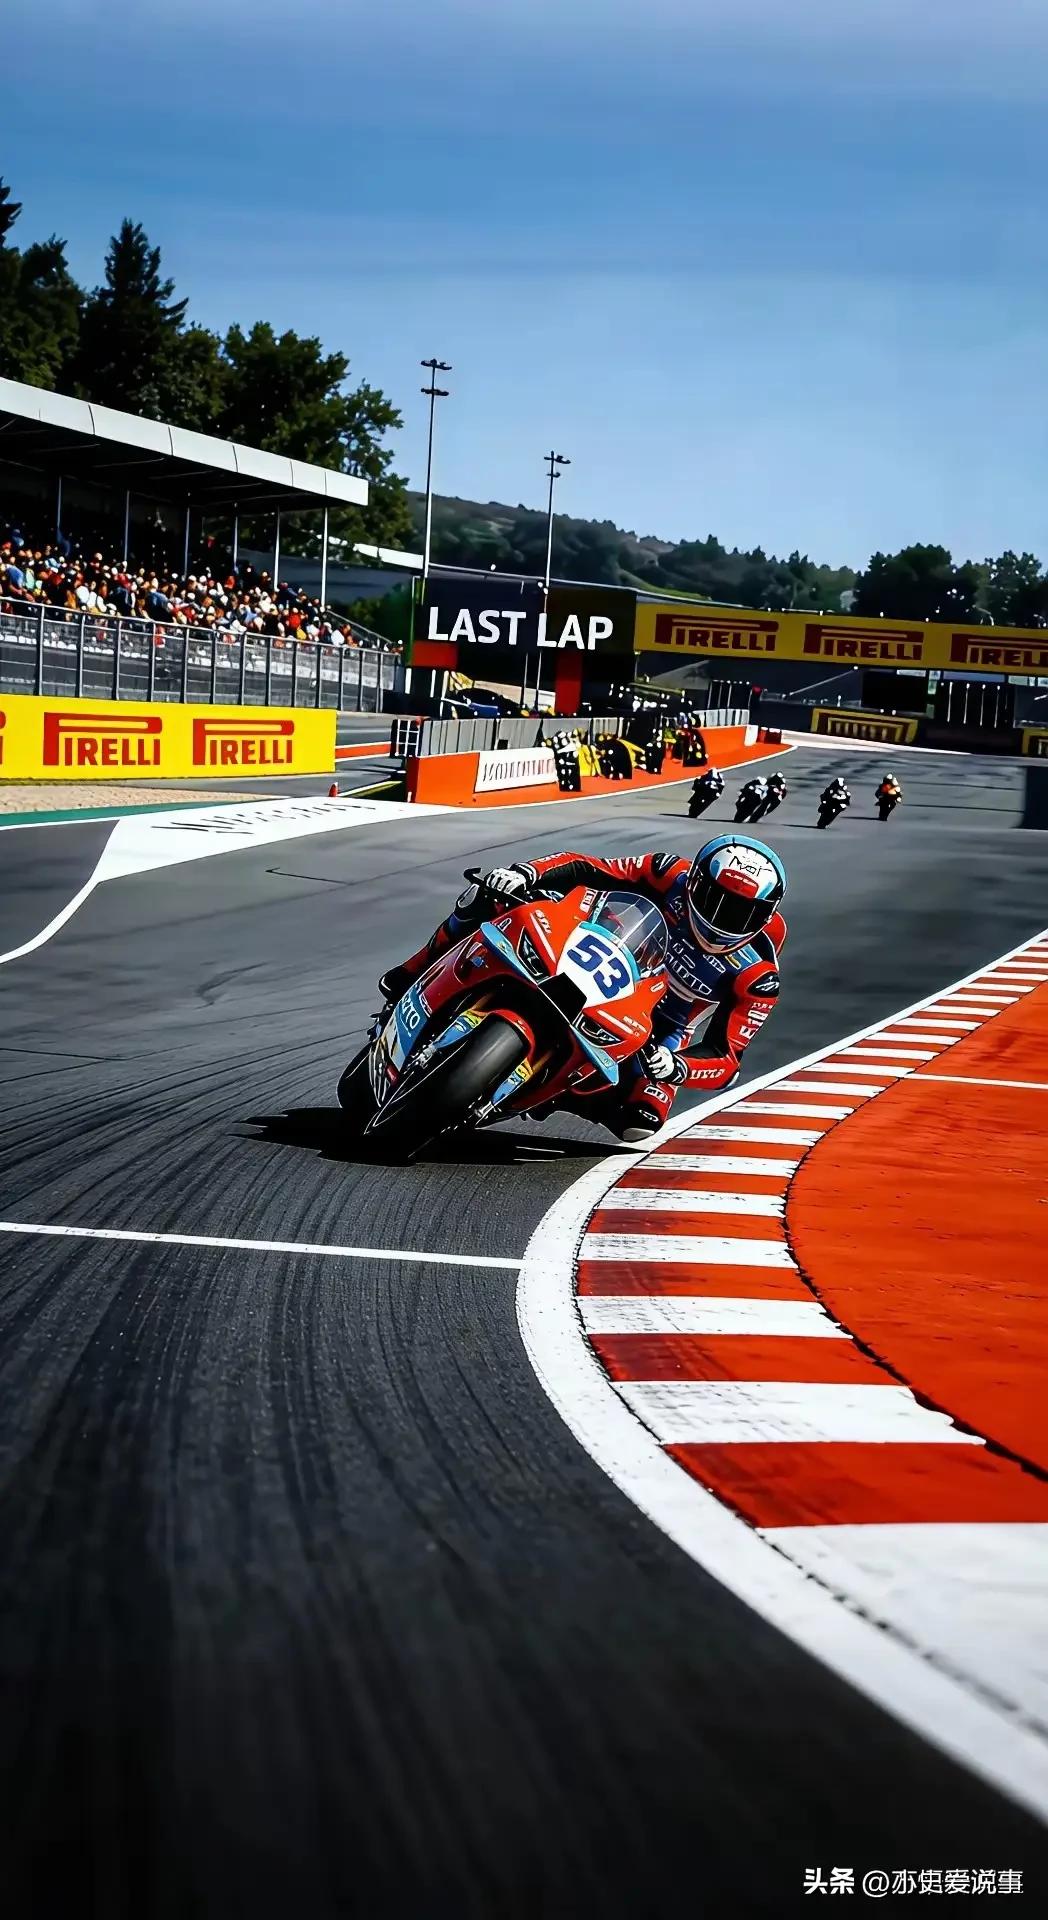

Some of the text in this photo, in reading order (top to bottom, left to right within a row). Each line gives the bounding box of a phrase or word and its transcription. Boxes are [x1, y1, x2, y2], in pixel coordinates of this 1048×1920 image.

[428, 606, 614, 651] LAST LAP
[654, 613, 780, 652] PIRELLI
[803, 623, 925, 661] PIRELLI
[43, 712, 163, 766] PIRELLI
[192, 718, 295, 766] PIRELLI
[566, 934, 630, 999] 53
